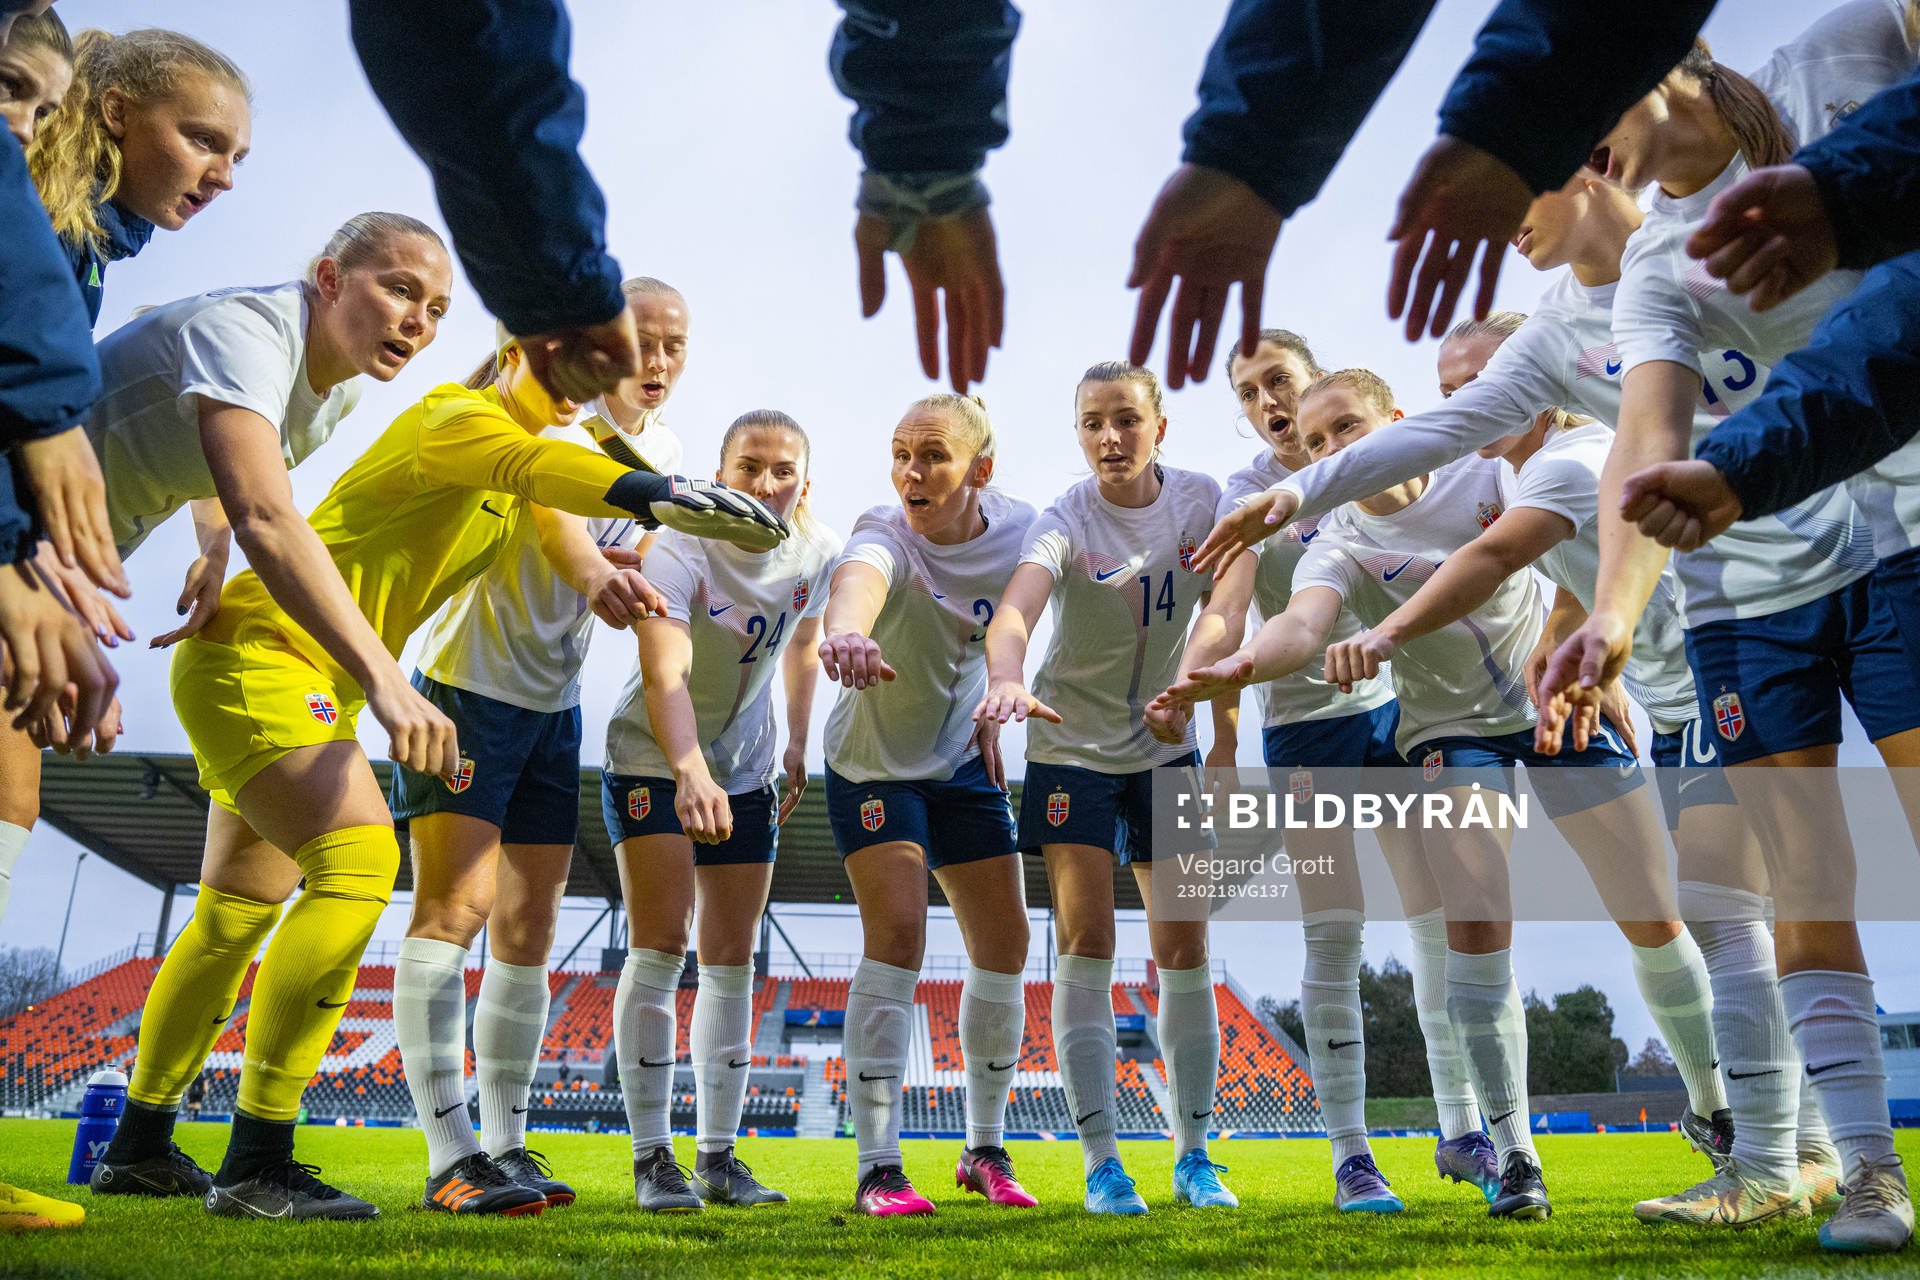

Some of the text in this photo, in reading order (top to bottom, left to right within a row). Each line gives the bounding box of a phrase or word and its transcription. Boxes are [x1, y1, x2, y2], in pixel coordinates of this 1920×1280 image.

[969, 598, 994, 642] 3
[1140, 570, 1176, 627] 14
[738, 612, 786, 664] 24
